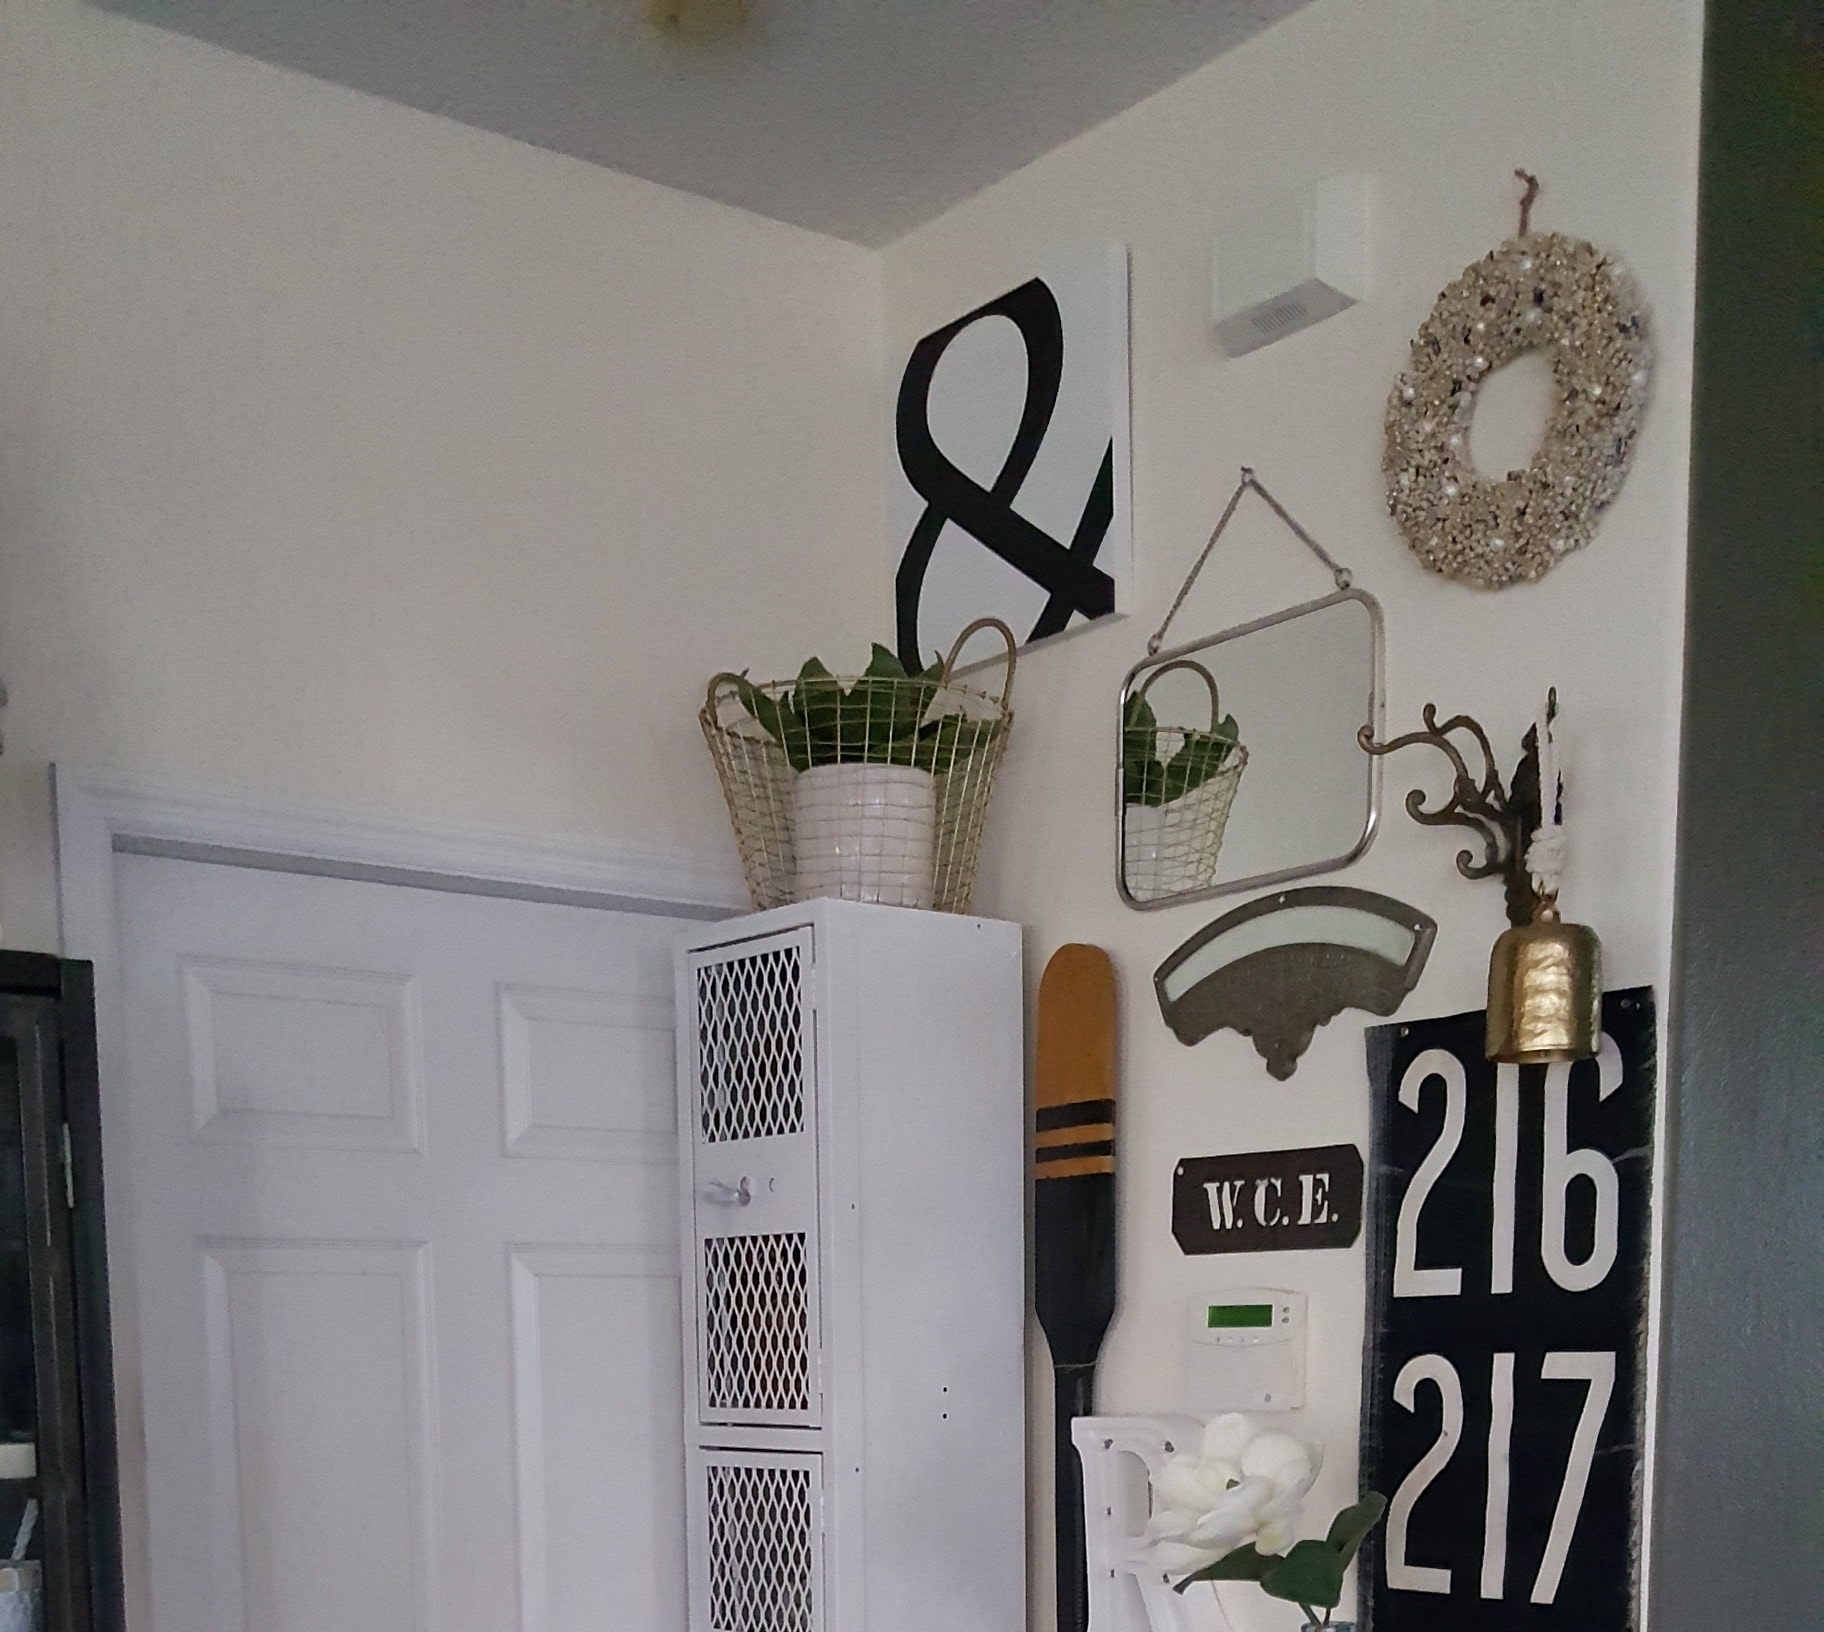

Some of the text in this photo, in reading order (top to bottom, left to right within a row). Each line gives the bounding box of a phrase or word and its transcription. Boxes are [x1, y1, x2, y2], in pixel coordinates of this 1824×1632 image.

[896, 276, 1115, 676] &
[1202, 1173, 1339, 1230] W.C.E.
[1393, 1031, 1623, 1297] 216
[1385, 1351, 1617, 1604] 217
